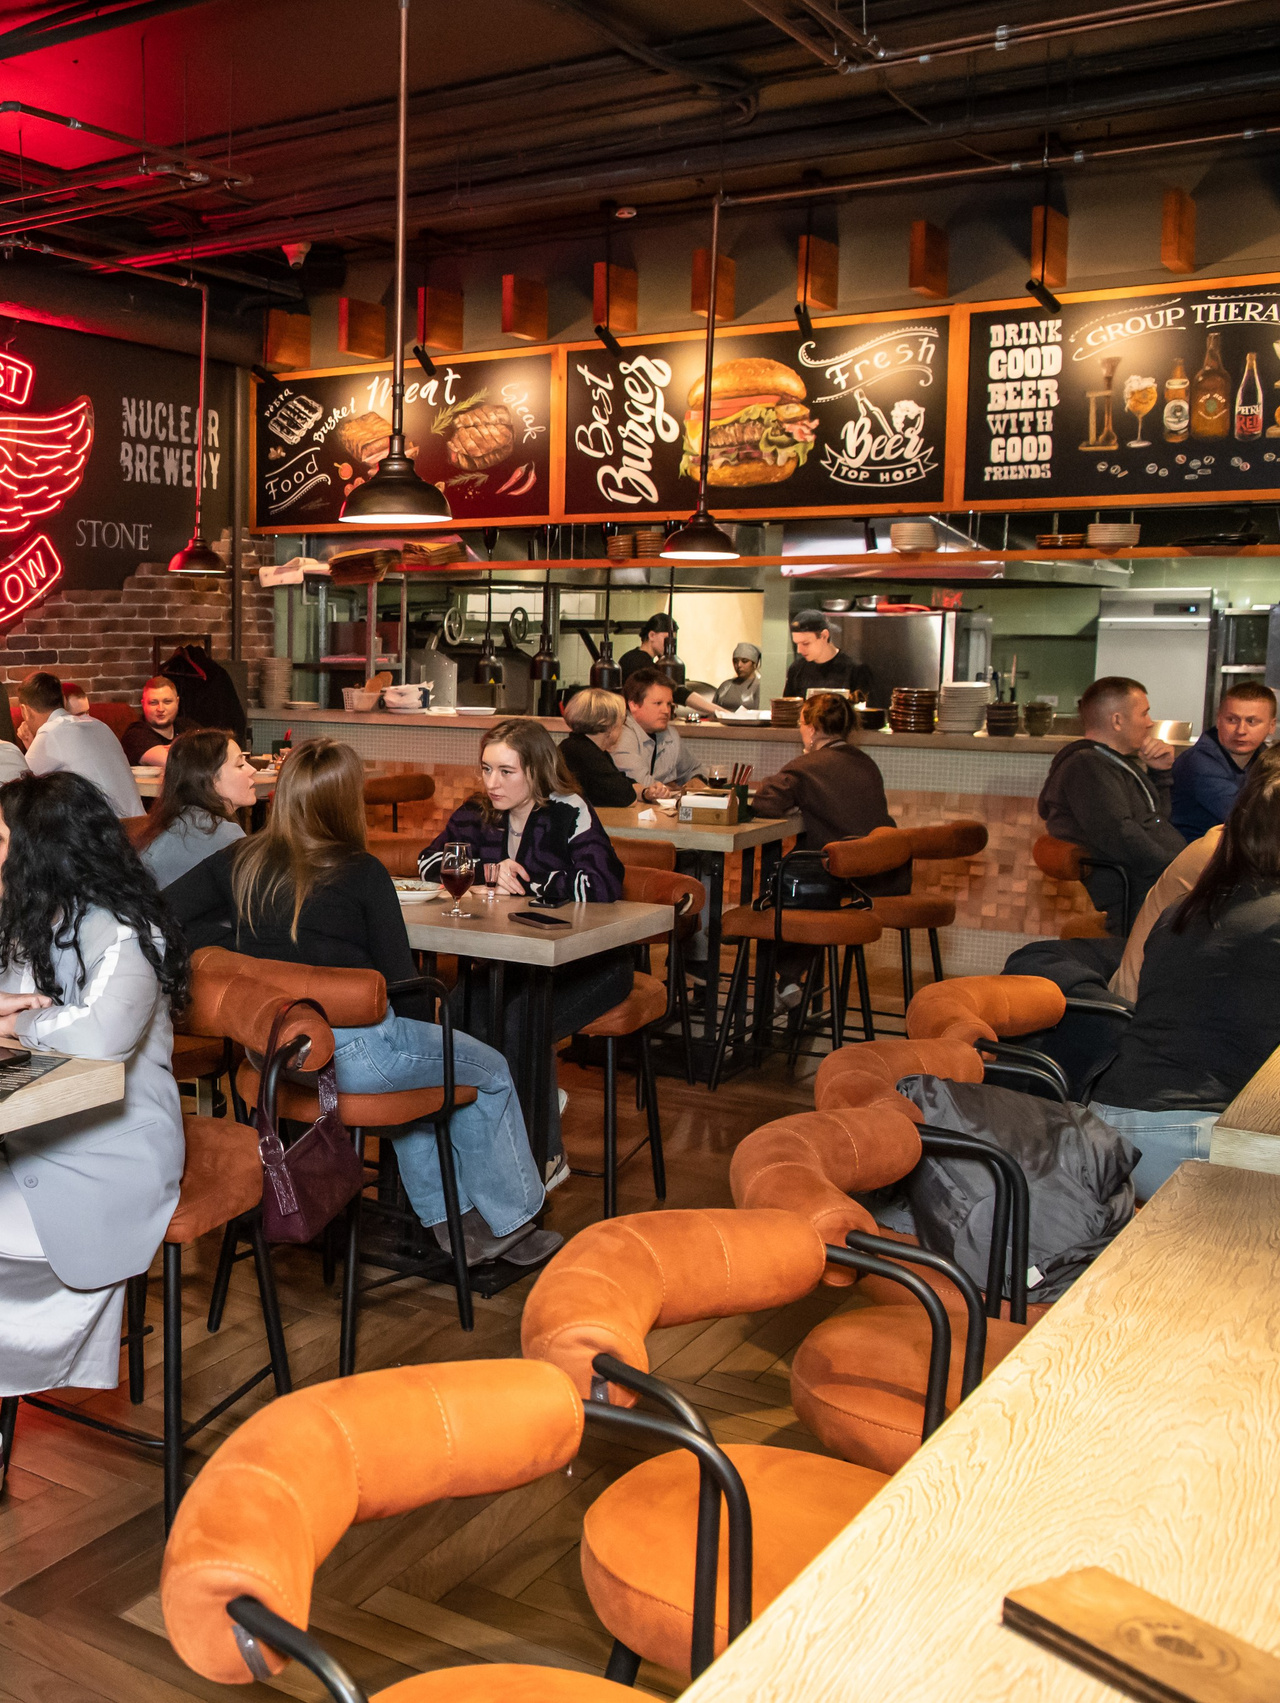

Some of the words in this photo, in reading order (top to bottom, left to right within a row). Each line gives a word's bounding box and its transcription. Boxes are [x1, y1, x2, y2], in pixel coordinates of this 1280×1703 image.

[989, 319, 1063, 348] DRINK
[1086, 306, 1186, 348] GROUP
[825, 337, 937, 391] Fresh
[988, 344, 1063, 380] GOOD
[366, 367, 462, 411] Meat
[987, 378, 1061, 412] BEER
[500, 382, 547, 444] Steak
[575, 363, 614, 458] Best
[986, 410, 1054, 436] WITH
[840, 416, 925, 468] Beer
[990, 434, 1054, 463] GOOD
[265, 453, 320, 501] Food
[840, 466, 870, 481] TOP
[880, 467, 918, 482] HOP
[984, 463, 1052, 482] FRIENDS
[75, 518, 150, 551] STONE
